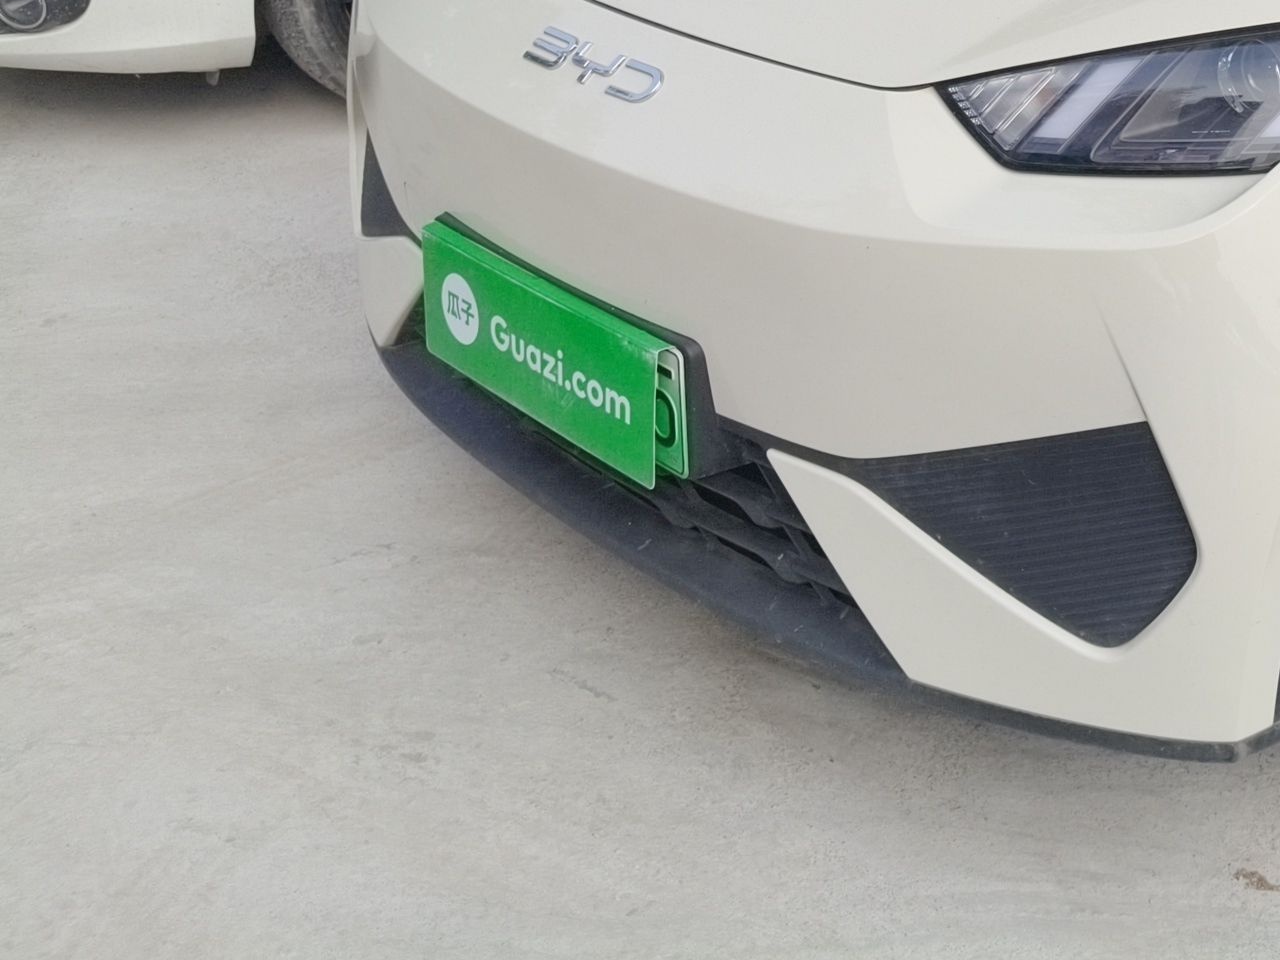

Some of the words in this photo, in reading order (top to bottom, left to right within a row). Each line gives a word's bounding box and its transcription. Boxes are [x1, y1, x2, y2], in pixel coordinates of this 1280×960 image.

[523, 26, 664, 103] BYD
[447, 290, 475, 326] 瓜子
[490, 315, 631, 425] Guazi.com
